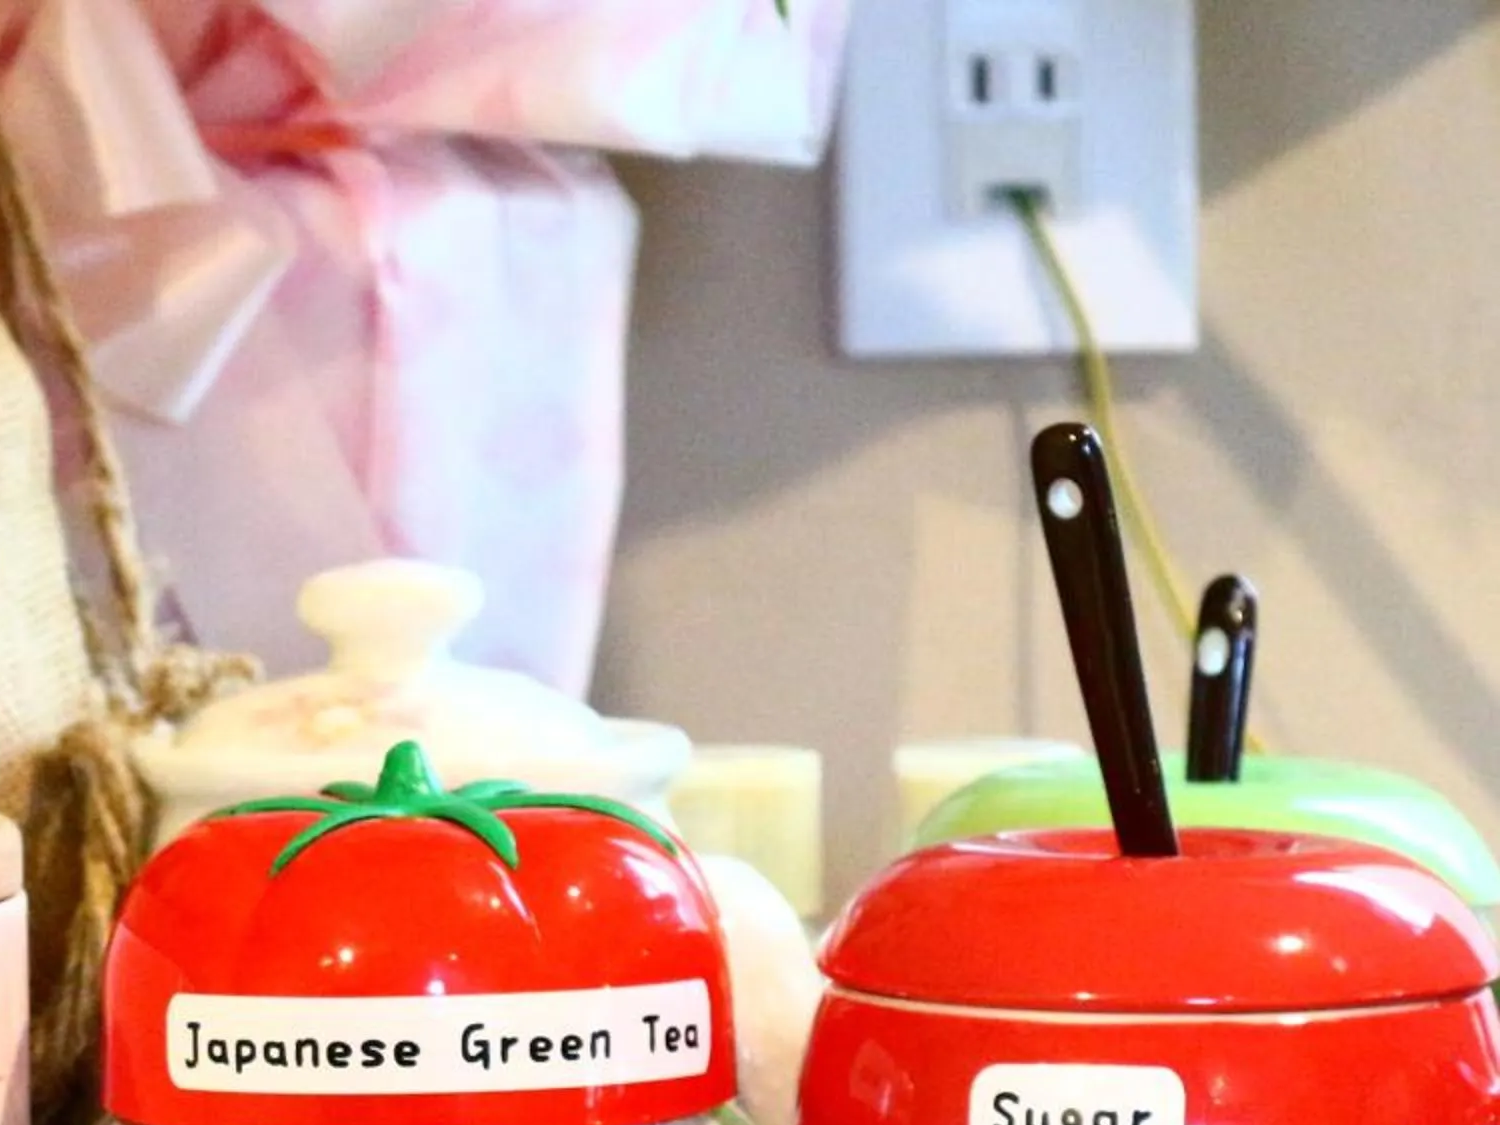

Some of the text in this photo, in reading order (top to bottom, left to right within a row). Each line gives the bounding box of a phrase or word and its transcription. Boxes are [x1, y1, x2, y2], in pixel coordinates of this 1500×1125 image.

[184, 1014, 700, 1074] Japanese Green Tea
